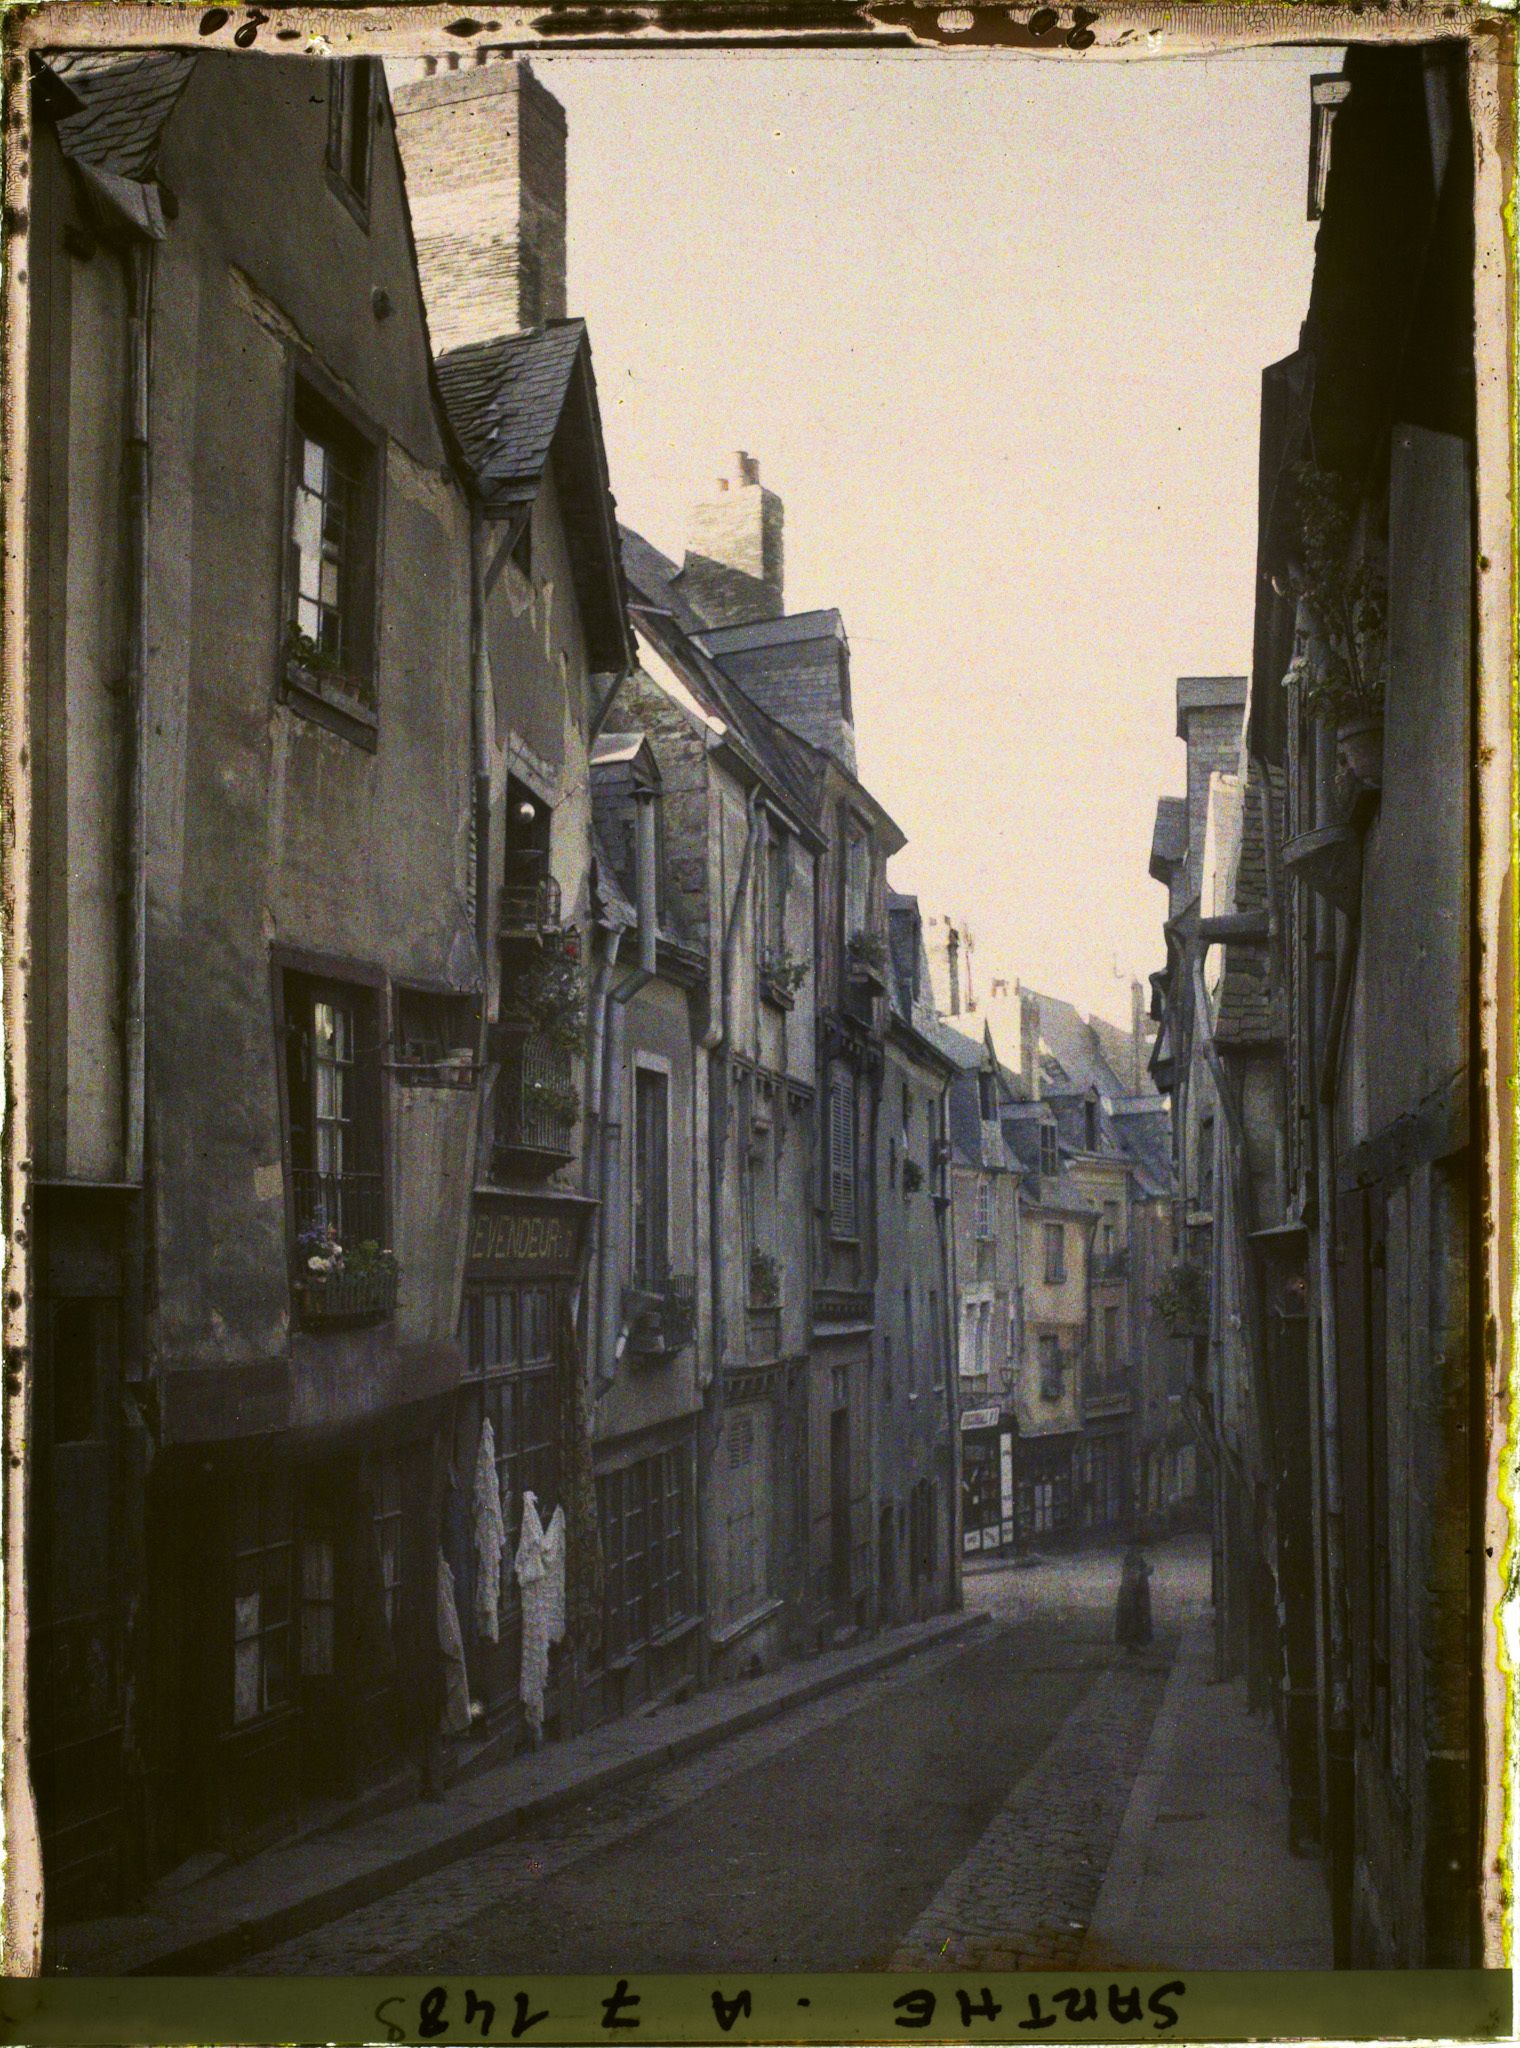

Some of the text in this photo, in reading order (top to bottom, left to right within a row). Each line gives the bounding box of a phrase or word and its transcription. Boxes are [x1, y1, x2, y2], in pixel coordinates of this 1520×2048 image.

[601, 1979, 641, 2028] 7
[710, 1989, 752, 2031] A
[893, 1981, 1186, 2029] SARTHE
